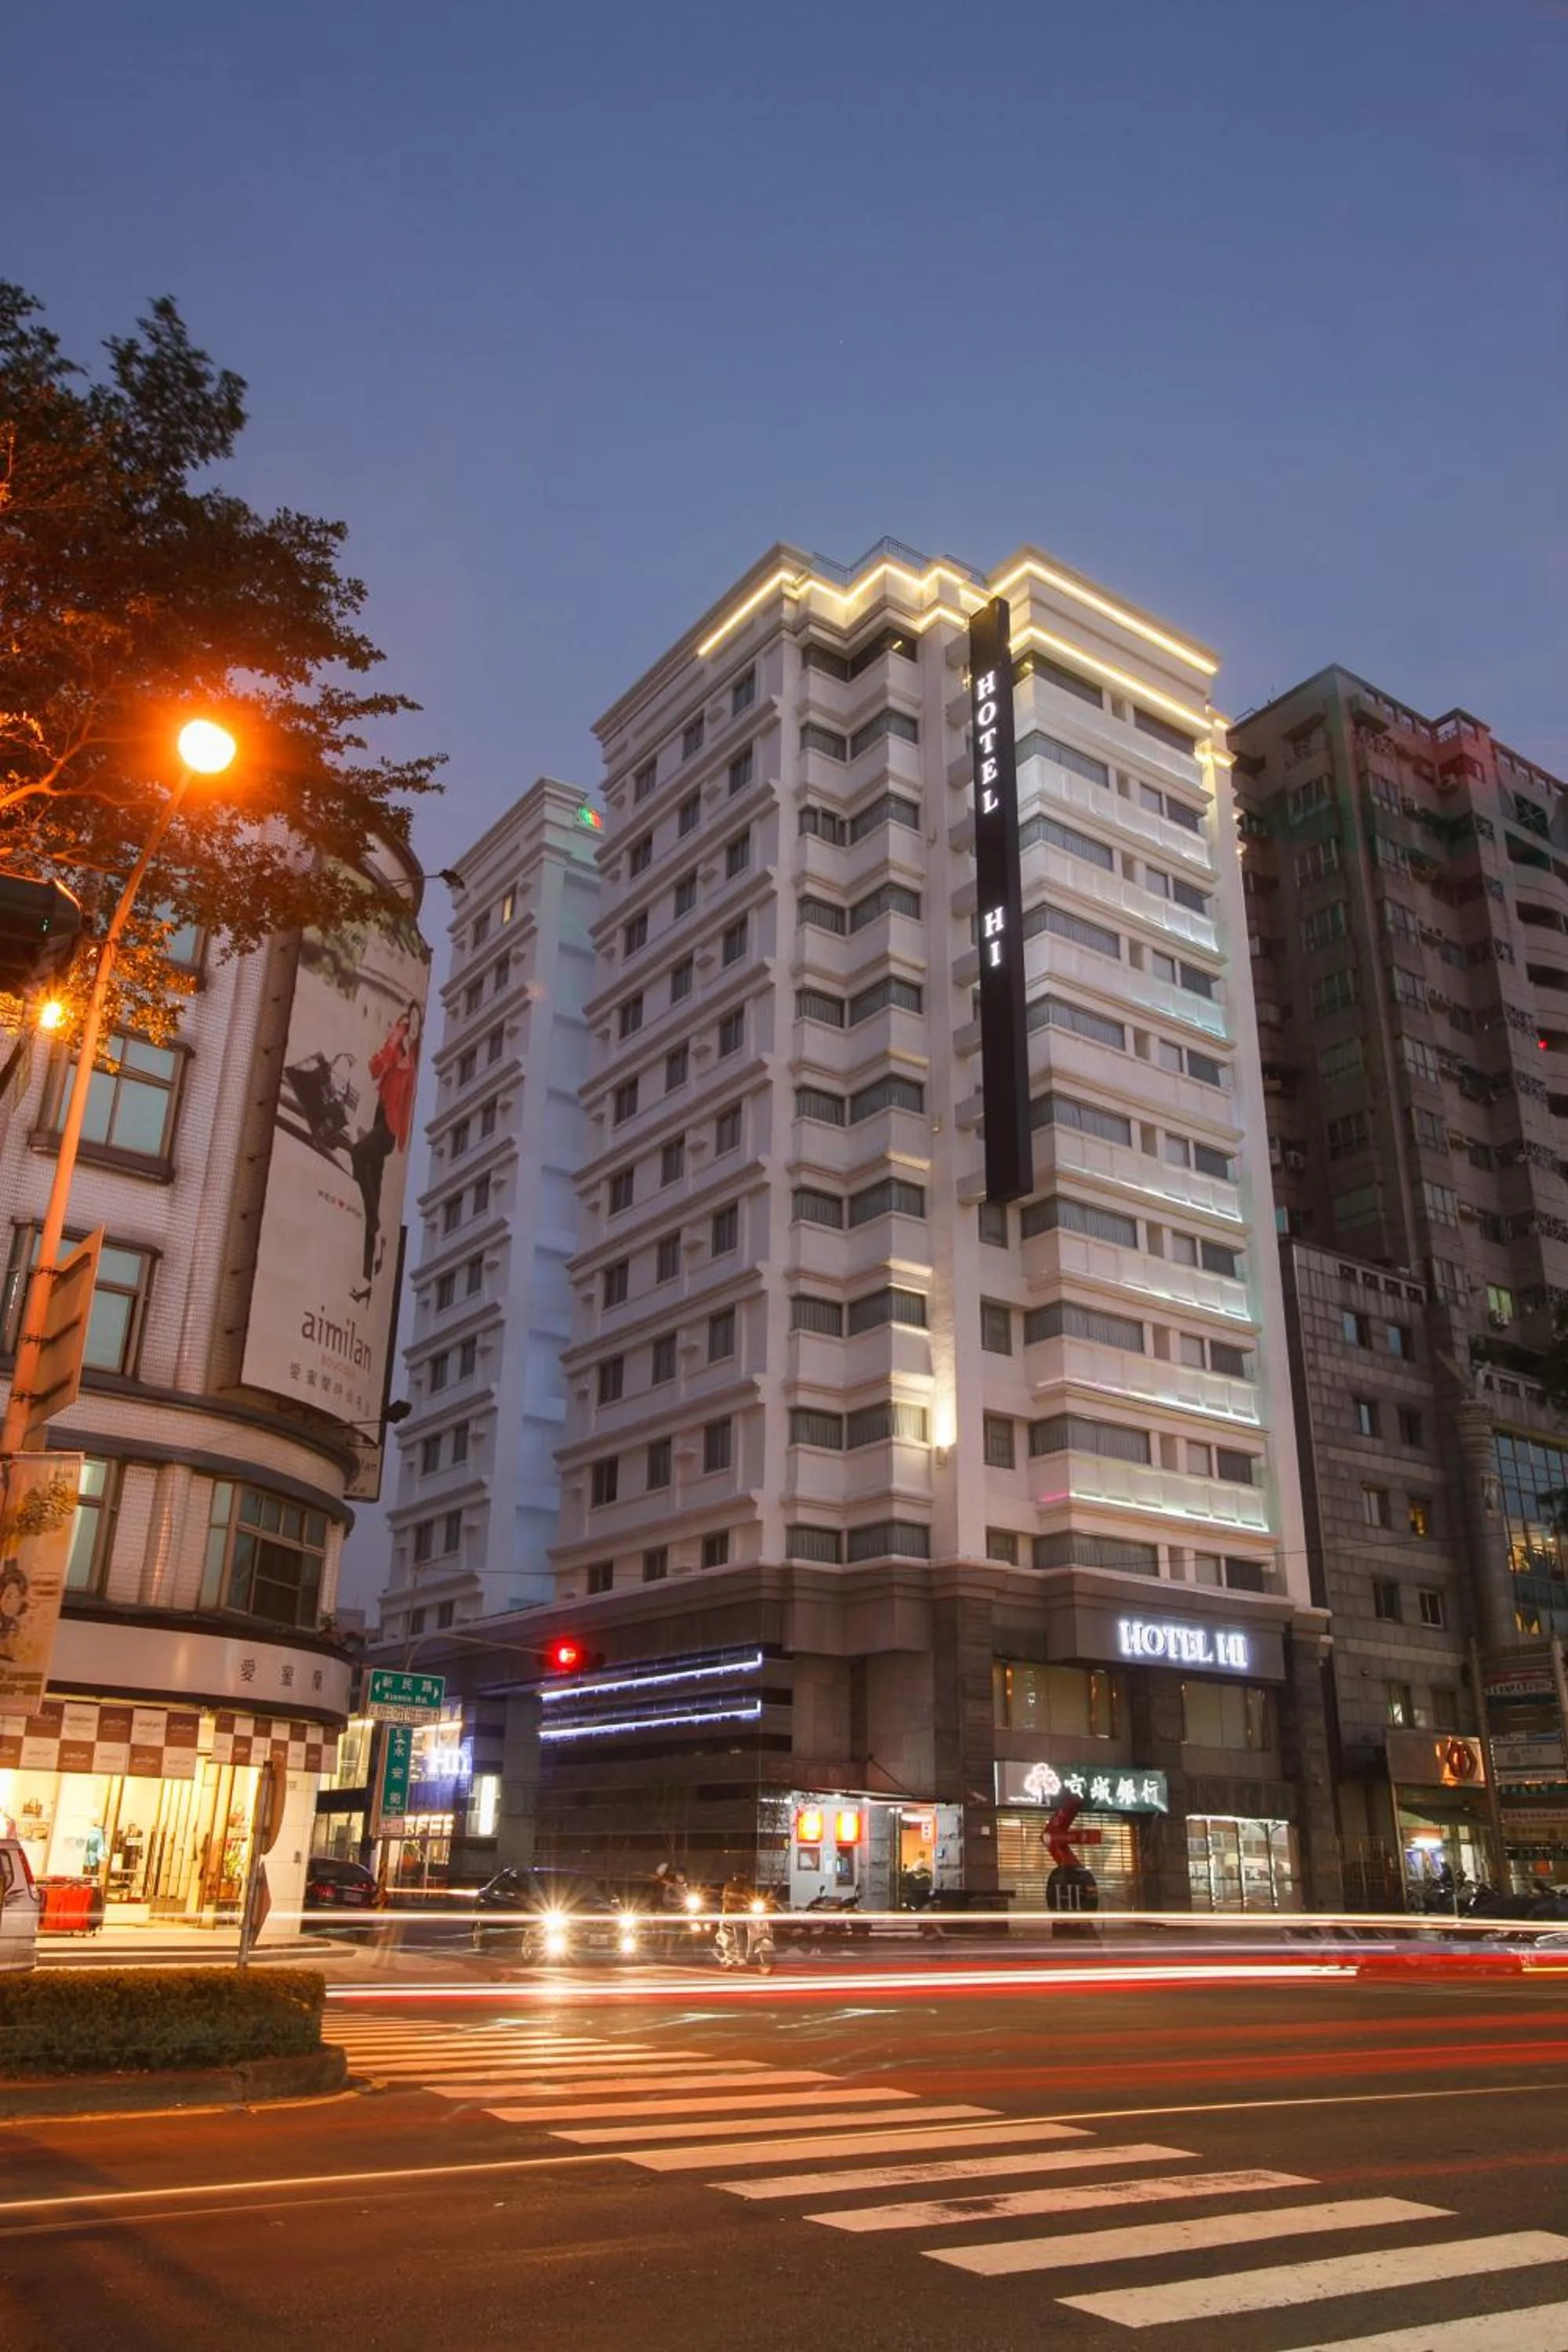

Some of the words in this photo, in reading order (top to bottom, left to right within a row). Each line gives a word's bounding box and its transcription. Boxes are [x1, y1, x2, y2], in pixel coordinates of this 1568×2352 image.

[977, 670, 998, 814] HOTEL
[984, 906, 1004, 966] HI
[301, 1305, 372, 1374] aimilan
[1119, 1618, 1213, 1663] HOTEL
[1215, 1632, 1248, 1668] HI
[1054, 1883, 1081, 1911] HI
